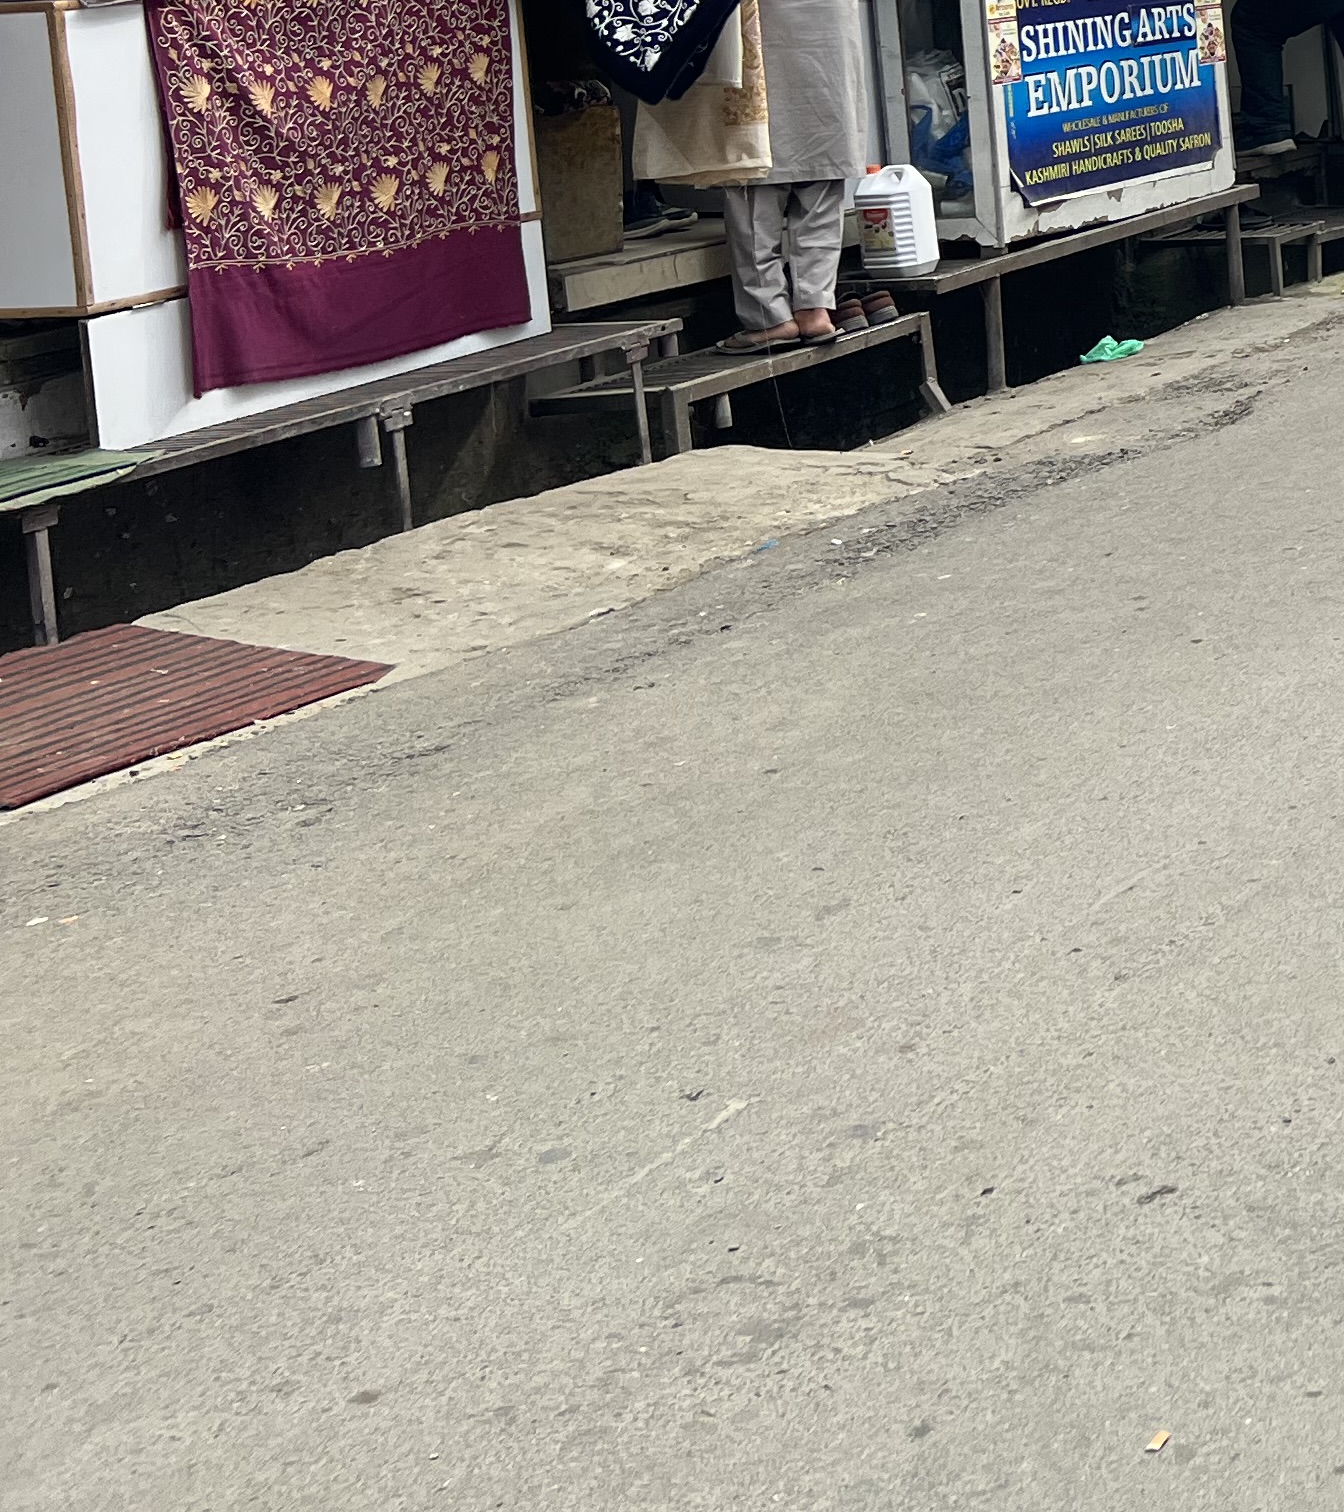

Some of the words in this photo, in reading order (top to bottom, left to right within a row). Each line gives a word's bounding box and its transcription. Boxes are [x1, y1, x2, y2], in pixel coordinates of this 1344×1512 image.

[1020, 11, 1133, 63] SHINING
[1136, 2, 1197, 44] ARTS
[1025, 48, 1202, 118] EMPORIUM
[1025, 166, 1070, 186] KASHMIRI
[1072, 148, 1133, 177] HANDICRAFTS
[1135, 147, 1143, 161] &
[1143, 141, 1179, 161] QUALITY
[1179, 132, 1211, 151] SAFRON
